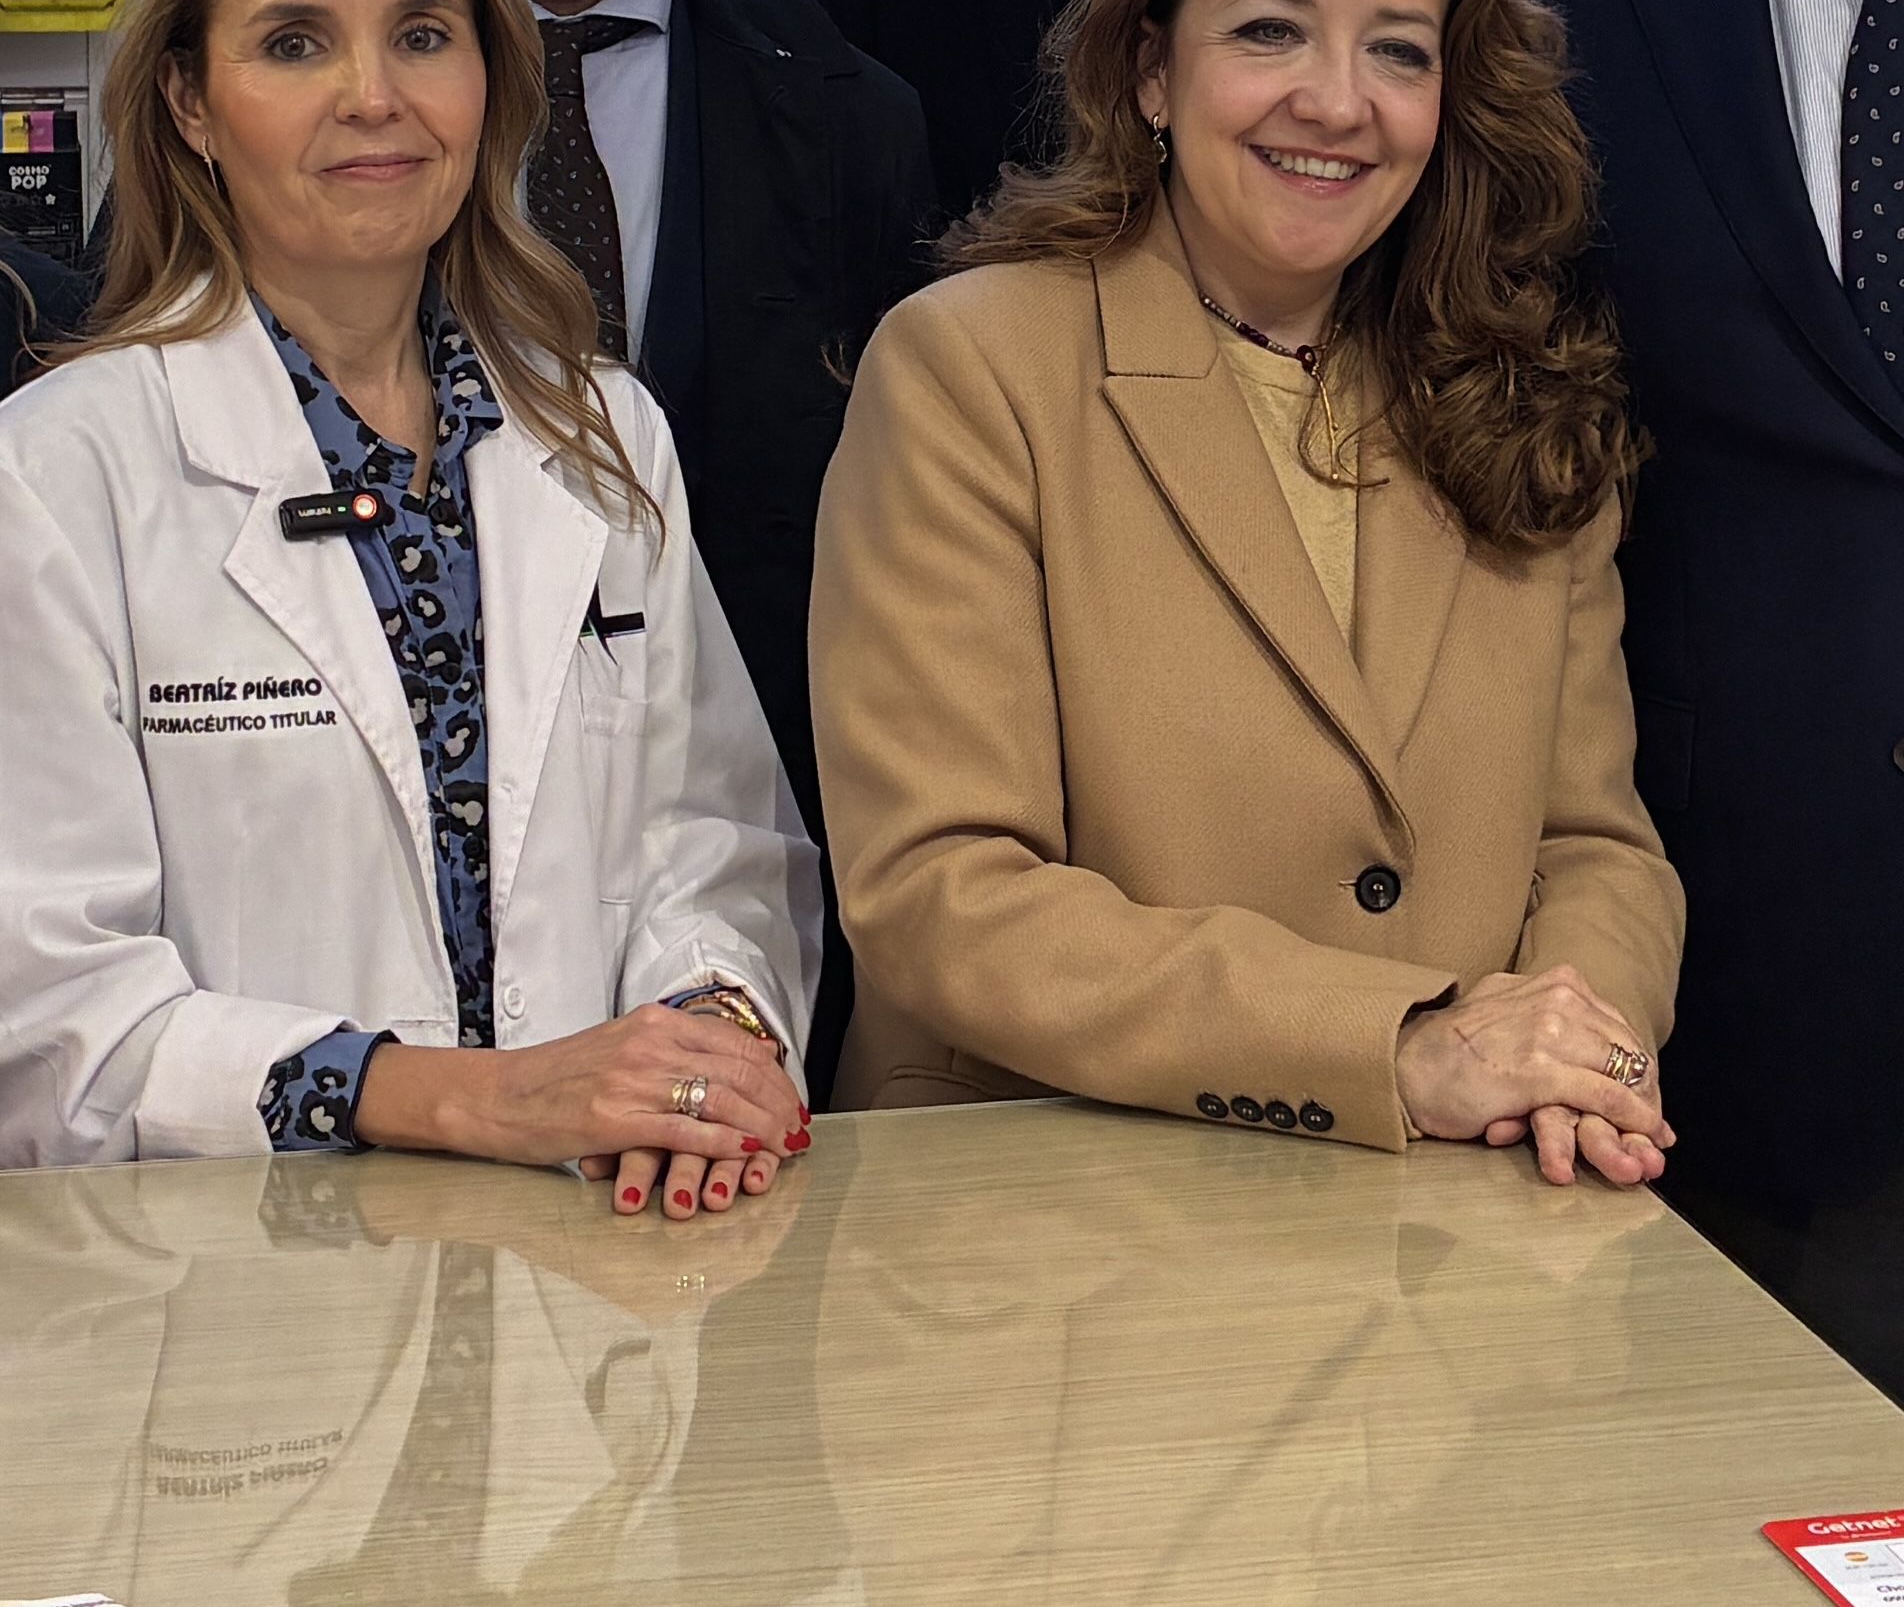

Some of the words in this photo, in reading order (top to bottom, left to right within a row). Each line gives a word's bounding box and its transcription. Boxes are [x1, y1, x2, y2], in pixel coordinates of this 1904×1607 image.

[11, 175, 47, 191] POP
[149, 676, 237, 704] BEATRÍZ
[241, 674, 323, 701] PIÑERO
[270, 710, 337, 729] TITULAR
[1807, 1516, 1900, 1536] Getnet
